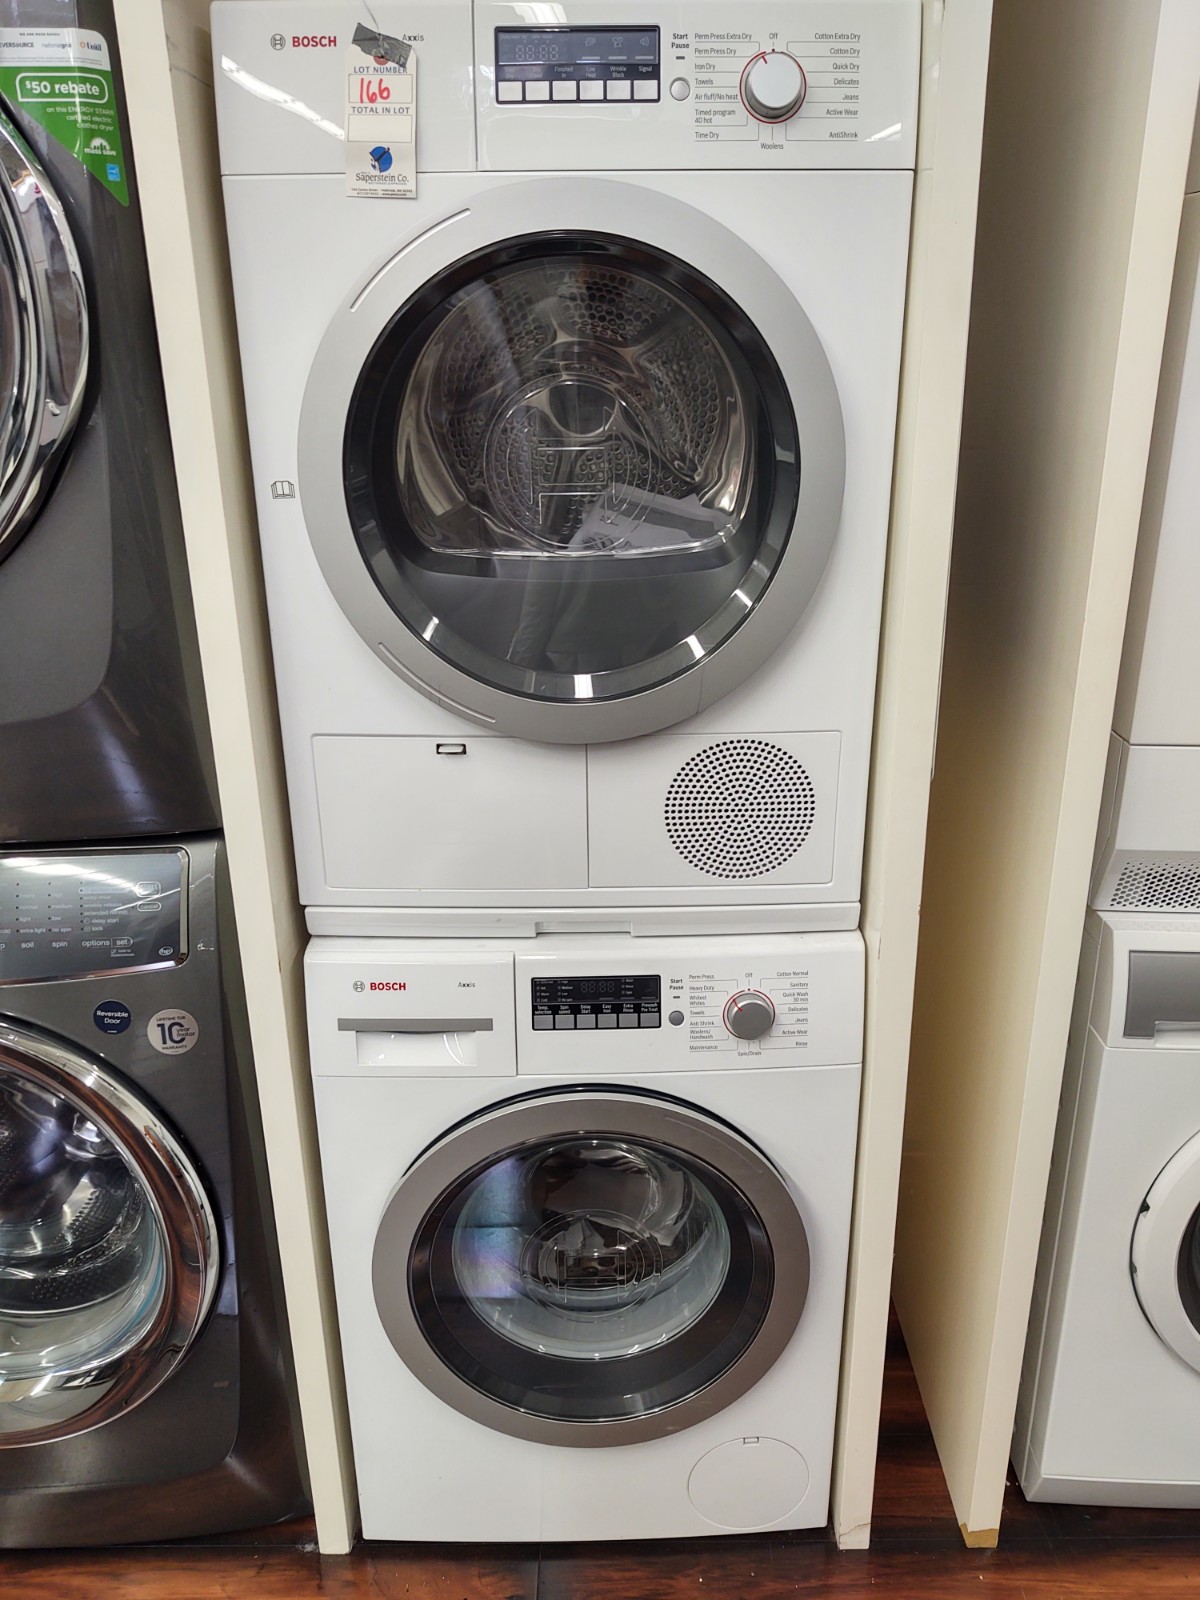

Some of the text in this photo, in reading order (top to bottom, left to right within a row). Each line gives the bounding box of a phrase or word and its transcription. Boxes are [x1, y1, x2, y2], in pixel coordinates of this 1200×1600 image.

[402, 34, 424, 42] Axxis
[742, 33, 752, 41] Dry
[850, 33, 861, 41] Dry
[292, 36, 337, 48] BOSCH
[727, 48, 736, 56] Dry
[850, 48, 860, 56] Dry
[354, 66, 407, 74] LOT NUMBER
[706, 63, 715, 71] Dry
[850, 63, 860, 71] Dry
[25, 81, 100, 96] $50 rebate
[360, 78, 390, 104] 166
[352, 106, 379, 114] TOTAL
[713, 110, 735, 118] program
[710, 132, 719, 140] Dry
[356, 173, 409, 183] Saperstein Co.
[52, 941, 68, 949] spin
[370, 982, 406, 991] BOSCH
[157, 1022, 186, 1045] 10
